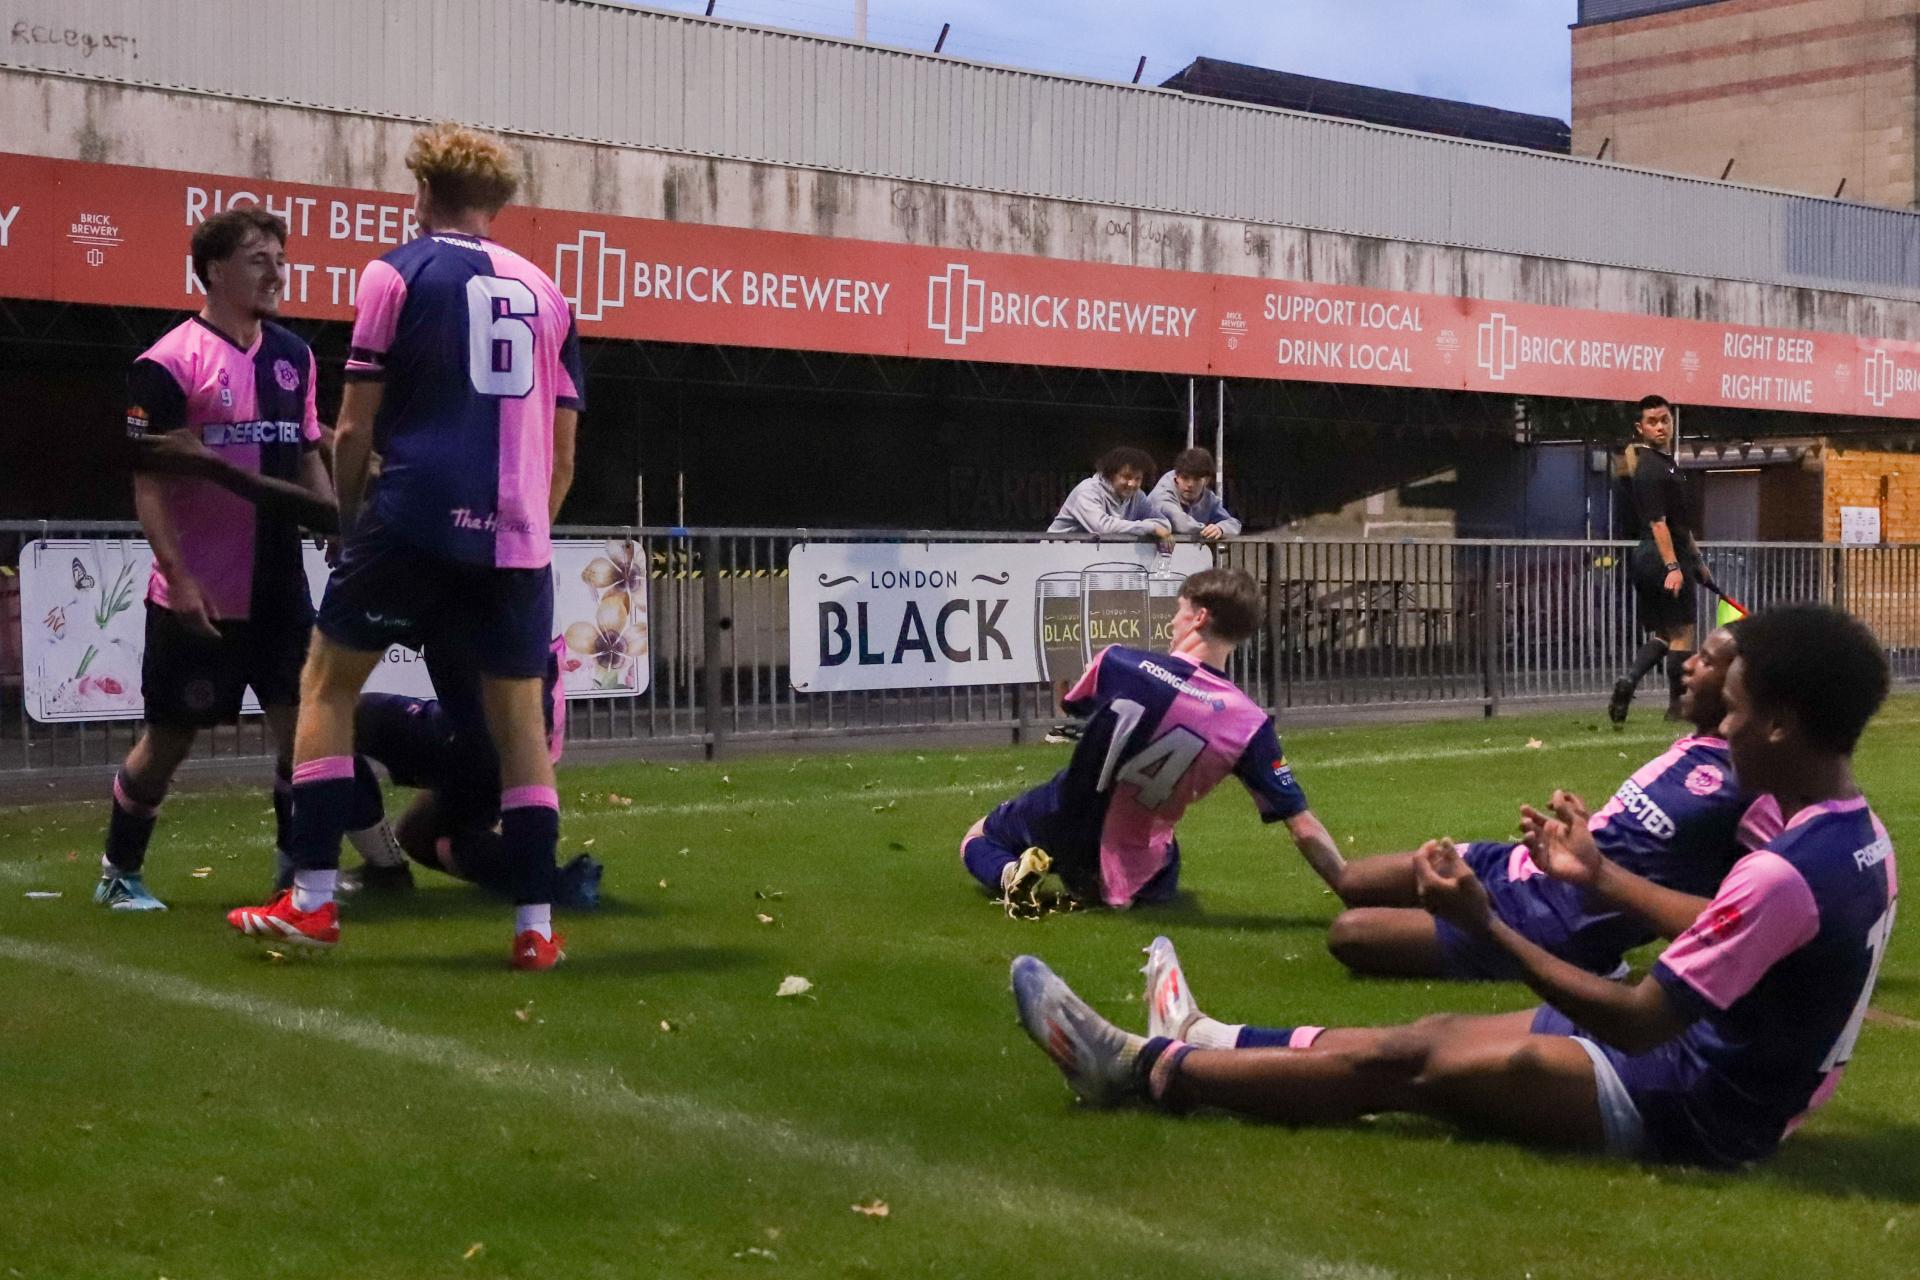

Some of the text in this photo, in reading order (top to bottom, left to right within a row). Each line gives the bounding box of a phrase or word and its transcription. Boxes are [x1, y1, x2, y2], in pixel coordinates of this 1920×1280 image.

[71, 223, 119, 237] BREWERY
[81, 213, 111, 225] BRICK
[633, 262, 890, 315] BRICK BREWERY
[990, 291, 1196, 337] BRICK BREWERY
[1263, 293, 1423, 332] SUPPORT LOCAL
[466, 274, 538, 398] 6
[1723, 332, 1774, 359] RIGHT
[1776, 339, 1814, 364] BEER
[1278, 338, 1413, 372] DRINK LOCAL
[1520, 335, 1576, 366] BRICK
[1580, 342, 1665, 372] BREWERY
[1721, 374, 1813, 404] RIGHT TIME
[1896, 367, 1920, 393] BRI
[221, 388, 232, 407] 9
[450, 508, 482, 529] The
[871, 570, 957, 590] LONDON
[818, 598, 1013, 667] BLACK
[1090, 619, 1140, 639] BLACK
[1096, 698, 1210, 810] 14
